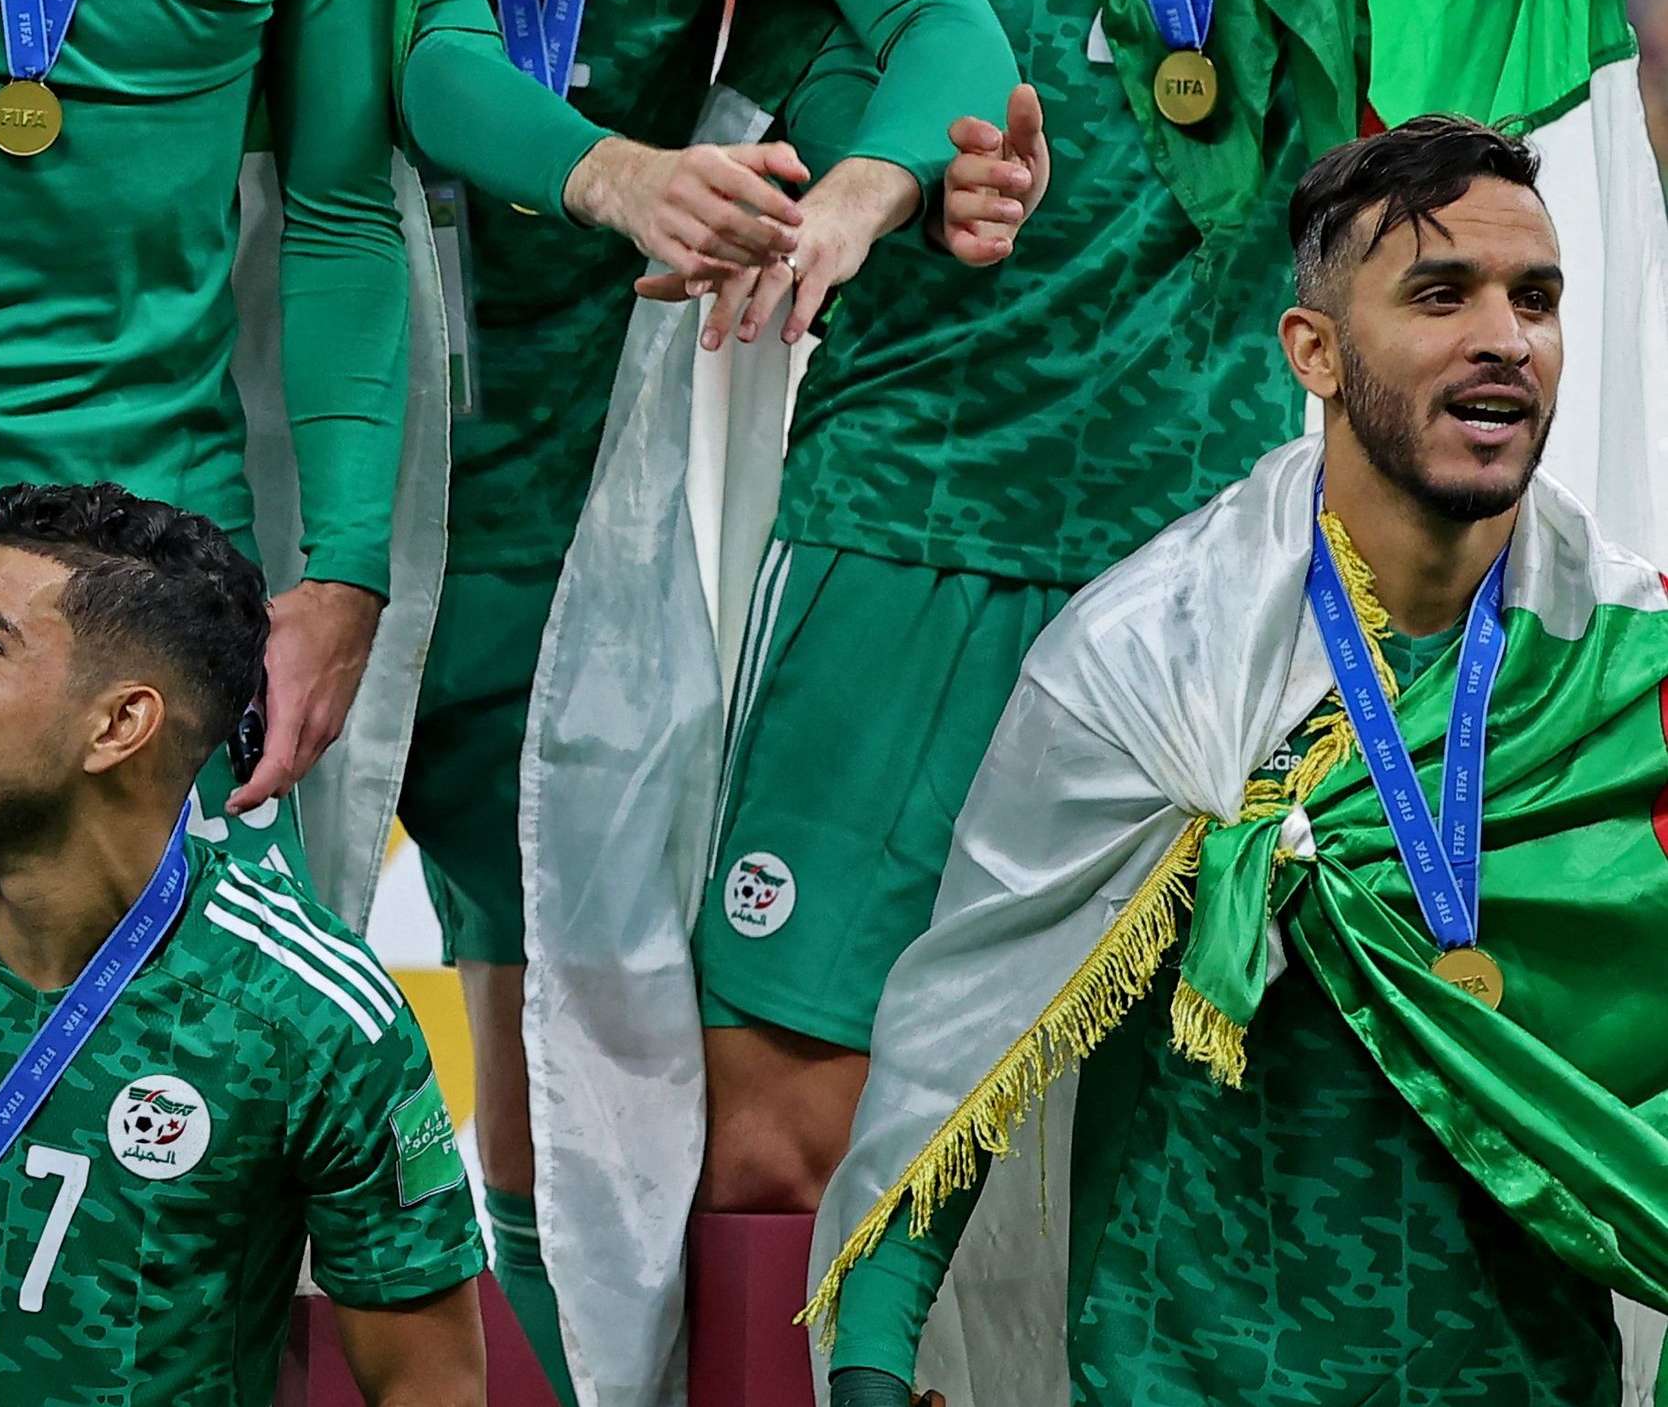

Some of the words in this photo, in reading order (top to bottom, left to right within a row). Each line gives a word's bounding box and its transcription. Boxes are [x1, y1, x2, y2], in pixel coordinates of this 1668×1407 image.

[19, 13, 33, 47] FIFA
[1165, 79, 1205, 97] FIFA
[0, 107, 49, 129] FIFA
[1322, 590, 1339, 621] FIFA
[1480, 614, 1493, 644] FIFA
[1338, 638, 1357, 670] FIFA
[1468, 661, 1482, 693] FIFA
[1356, 688, 1376, 720] FIFA
[1460, 713, 1473, 747] FIFA
[1375, 739, 1395, 772] FIFA
[1456, 767, 1468, 801] FIFA
[1394, 789, 1414, 822] FIFA
[1453, 822, 1465, 856] FIFA
[1413, 840, 1434, 873] FIFA
[160, 869, 180, 904] FIFA
[1433, 892, 1453, 924] FIFA
[128, 915, 154, 948] FIFA
[95, 960, 121, 991] FIFA
[62, 1003, 88, 1036] FIFA
[30, 1047, 57, 1080] FIFA
[0, 1091, 25, 1125] FIFA
